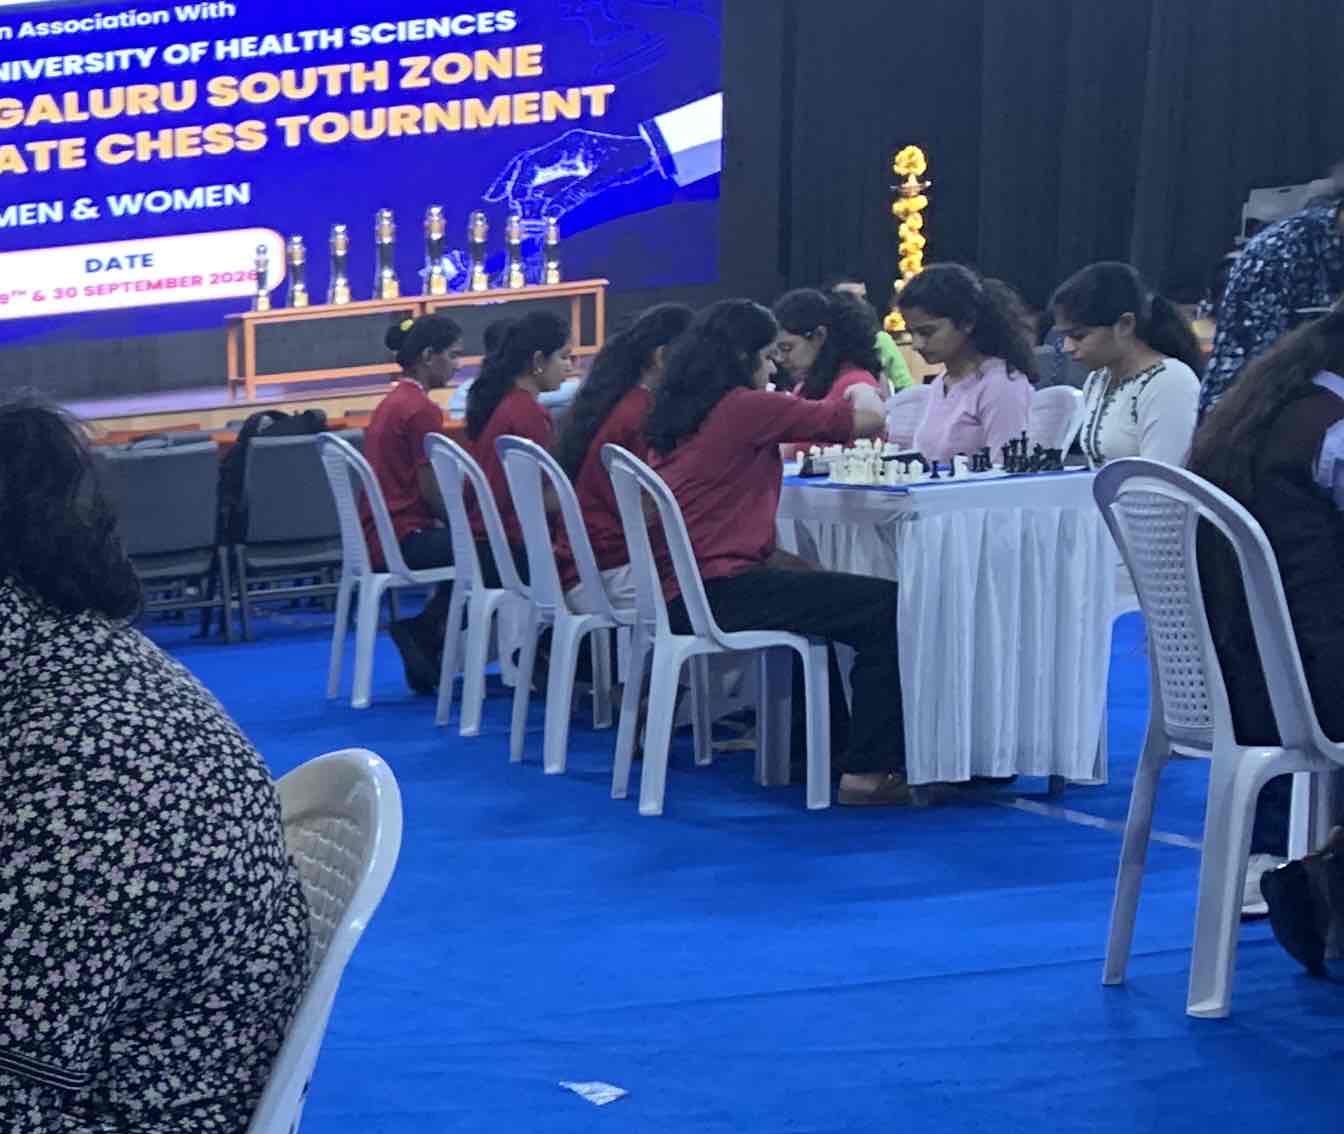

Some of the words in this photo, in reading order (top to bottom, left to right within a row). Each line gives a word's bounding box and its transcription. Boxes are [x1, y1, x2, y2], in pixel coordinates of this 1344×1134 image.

[17, 9, 170, 39] Association
[174, 0, 236, 22] With
[162, 41, 210, 65] OF
[215, 27, 344, 61] HEALTH
[349, 9, 517, 47] SCIENCES
[206, 60, 389, 107] SOUTH
[399, 43, 543, 89] ZONE
[95, 118, 268, 165] CHESS
[276, 84, 616, 147] TOURNMENT
[70, 197, 101, 221] &
[106, 182, 251, 217] WOMEN
[84, 252, 155, 274] DATE
[32, 289, 47, 302] &
[52, 286, 79, 300] 30
[83, 274, 203, 297] SEPTEMBER
